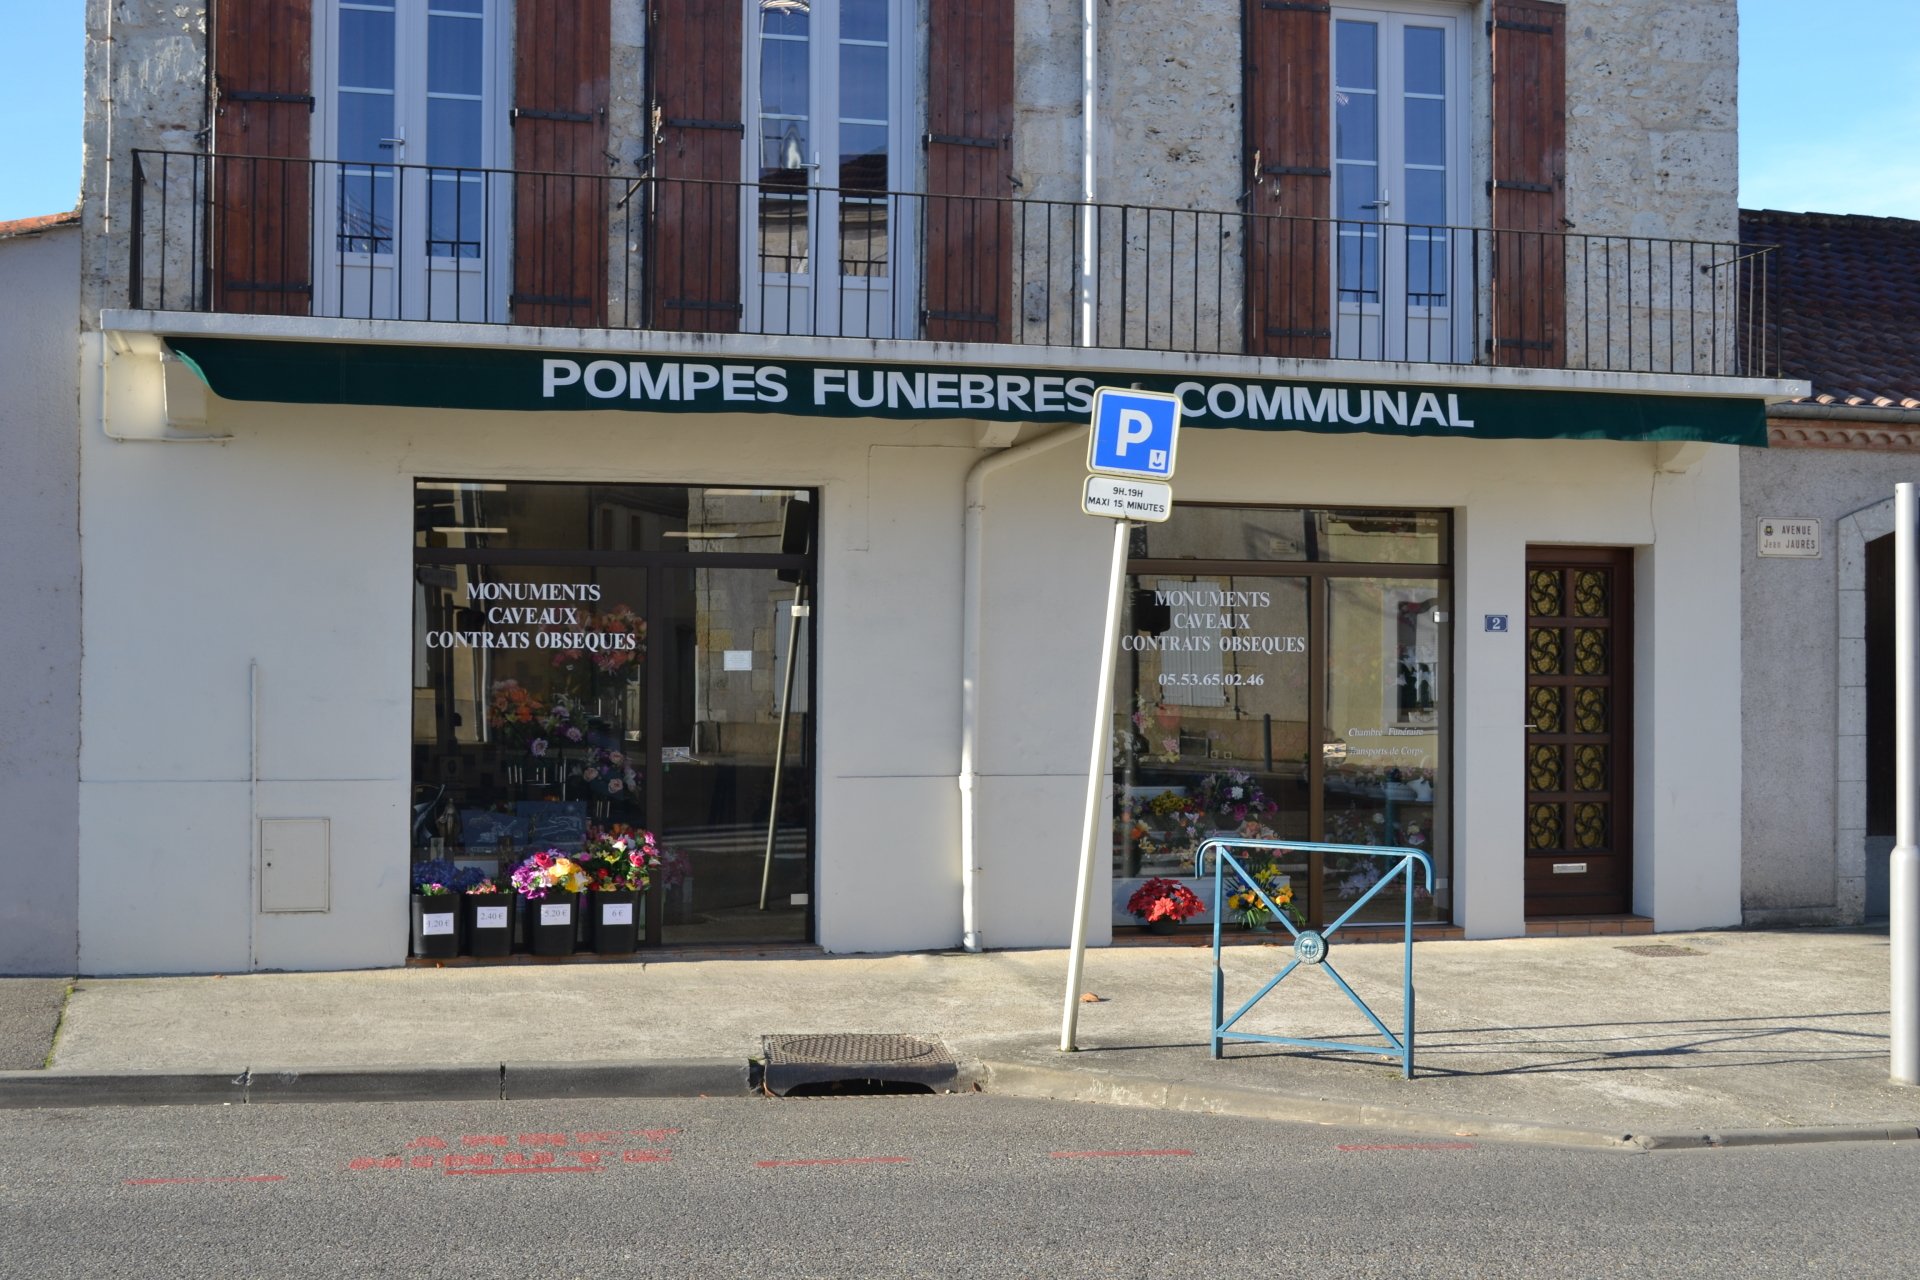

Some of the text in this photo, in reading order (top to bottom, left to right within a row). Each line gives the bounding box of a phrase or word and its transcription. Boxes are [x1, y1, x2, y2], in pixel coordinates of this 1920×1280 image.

[542, 358, 1475, 429] POMPES FUNEBRES COMMUNAL
[1115, 408, 1153, 457] P
[1087, 496, 1165, 513] MAXI 15 MINUTES
[1782, 525, 1811, 535] AVENUE
[1764, 539, 1781, 548] Jean
[465, 582, 601, 601] MONUMENTS
[1154, 590, 1271, 608] MONUMENTS
[488, 607, 578, 625] CAVEAUX
[1173, 613, 1251, 629] CAVEAUX
[1492, 617, 1501, 630] 2
[426, 631, 636, 652] CONTRATS OBSEQUES
[1121, 635, 1305, 655] CONTRATS OBSEQUES
[1158, 673, 1265, 686] 05.53.65.02.46
[1348, 727, 1425, 737] Chambre Funéraire
[1348, 746, 1425, 757] Transports de Corps
[480, 911, 497, 921] 2.40
